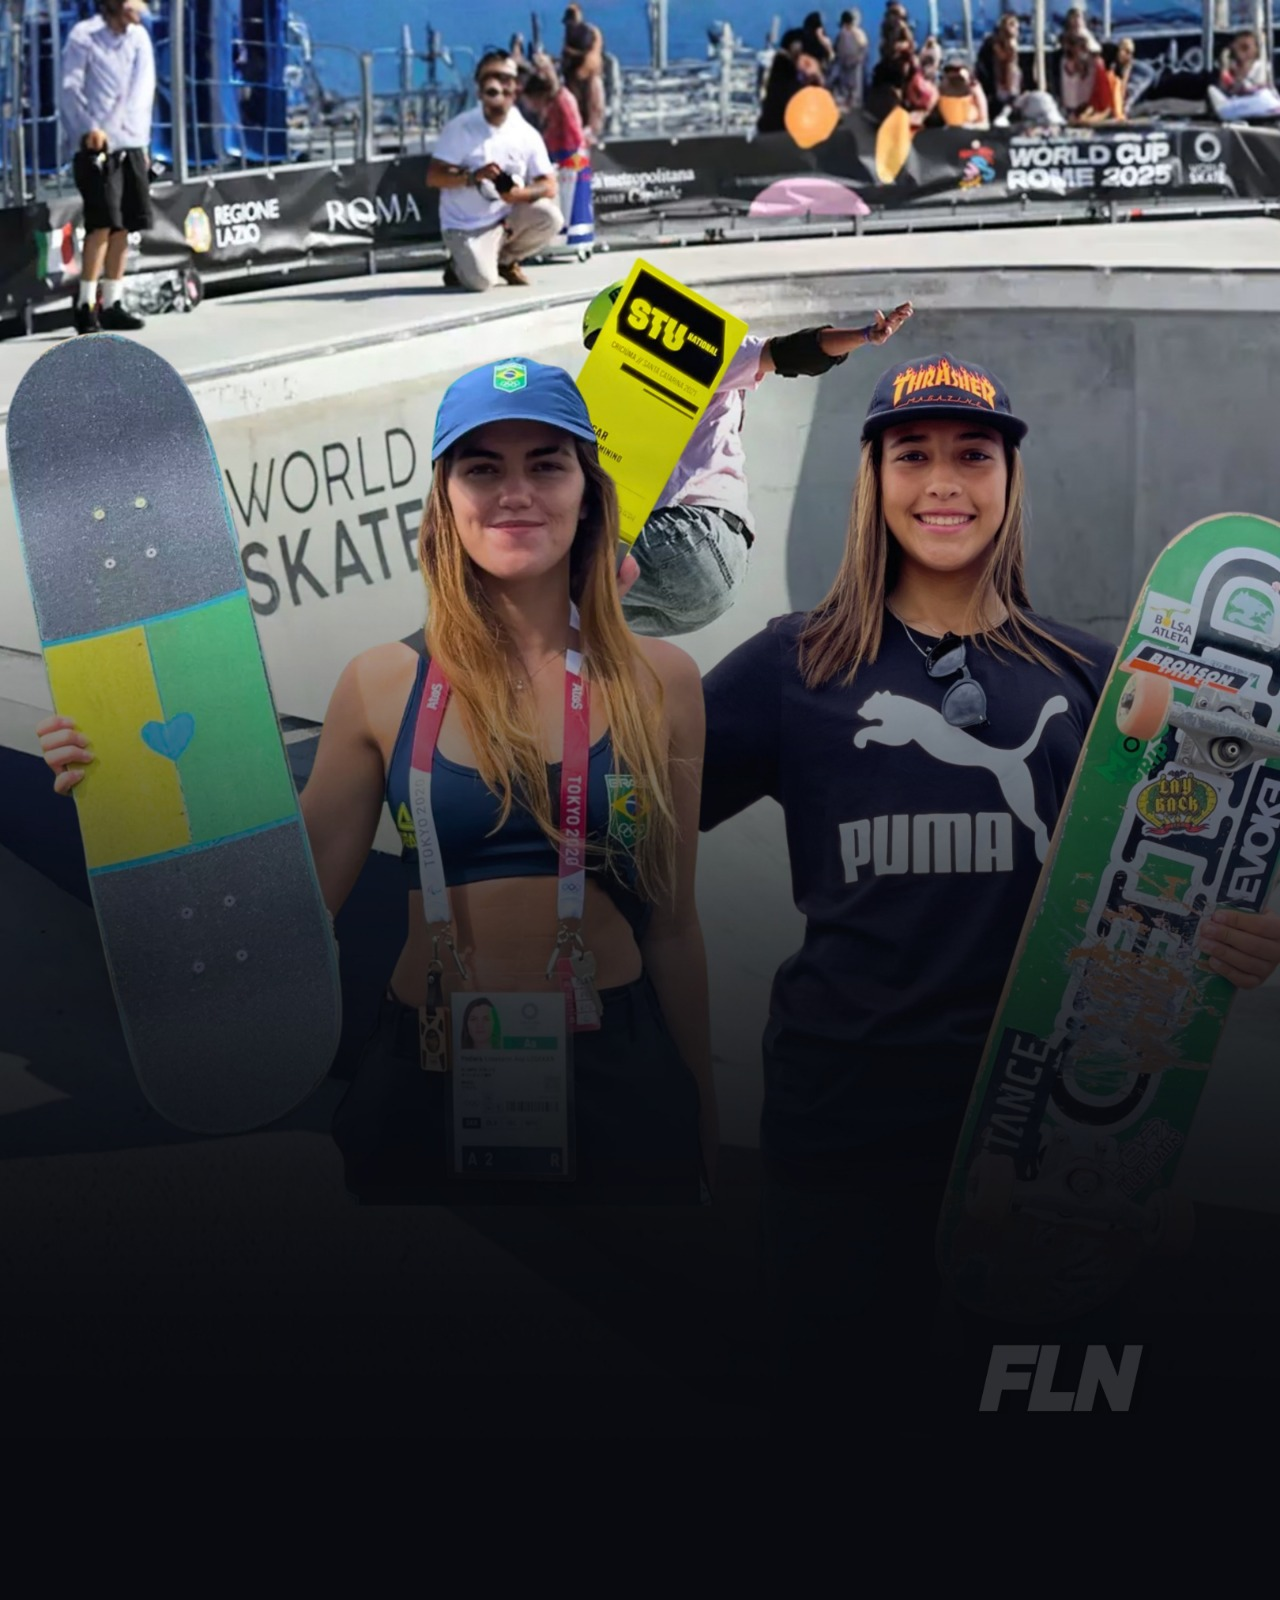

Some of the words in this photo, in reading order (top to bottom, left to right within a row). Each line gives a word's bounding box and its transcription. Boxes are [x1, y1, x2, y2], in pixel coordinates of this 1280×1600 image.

[1009, 144, 1111, 167] WORLD
[1115, 142, 1170, 165] CUP
[1007, 167, 1095, 190] ROME
[1101, 164, 1173, 188] 2025
[214, 198, 280, 226] REGIONE
[326, 193, 421, 232] ROMA
[215, 222, 261, 248] LAZIO
[627, 297, 688, 351] STU
[687, 332, 719, 357] NATIONAL
[642, 359, 660, 375] SANTA
[659, 367, 685, 390] CATARINA
[893, 358, 997, 410] THRASHER
[905, 395, 984, 408] MAGAZINE
[592, 424, 609, 441] GAR
[596, 442, 623, 463] MININO
[225, 427, 417, 527] WORLD
[240, 498, 425, 616] SKATE
[1152, 626, 1189, 646] ATLETA
[1149, 652, 1235, 687] BRONSON
[413, 778, 427, 815] 2020
[565, 775, 582, 826] TOKYO
[416, 817, 435, 868] TOKYO
[565, 829, 581, 867] 2020
[838, 812, 1014, 884] PUMA
[1226, 777, 1280, 902] EVOKE
[981, 1033, 1050, 1152] TANCE
[468, 1151, 478, 1167] A
[484, 1151, 494, 1167] 2
[550, 1153, 560, 1168] R
